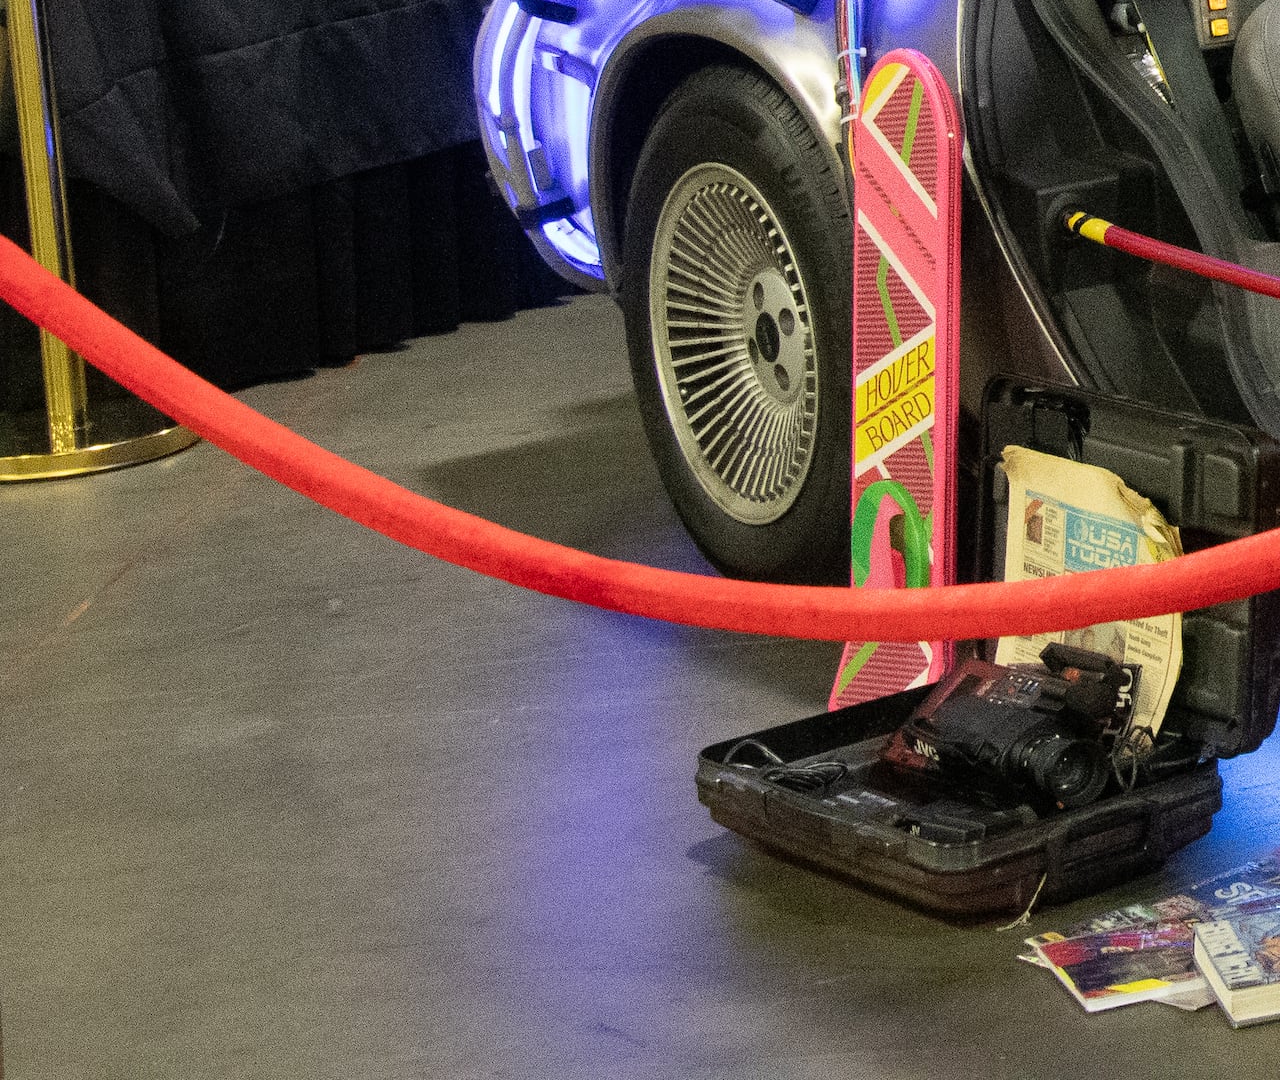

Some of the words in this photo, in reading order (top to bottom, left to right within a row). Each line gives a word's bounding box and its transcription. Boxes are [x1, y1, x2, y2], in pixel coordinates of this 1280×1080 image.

[866, 340, 930, 412] HOVER
[865, 391, 932, 452] BOARD
[1088, 524, 1134, 559] USA
[914, 739, 940, 761] JVC
